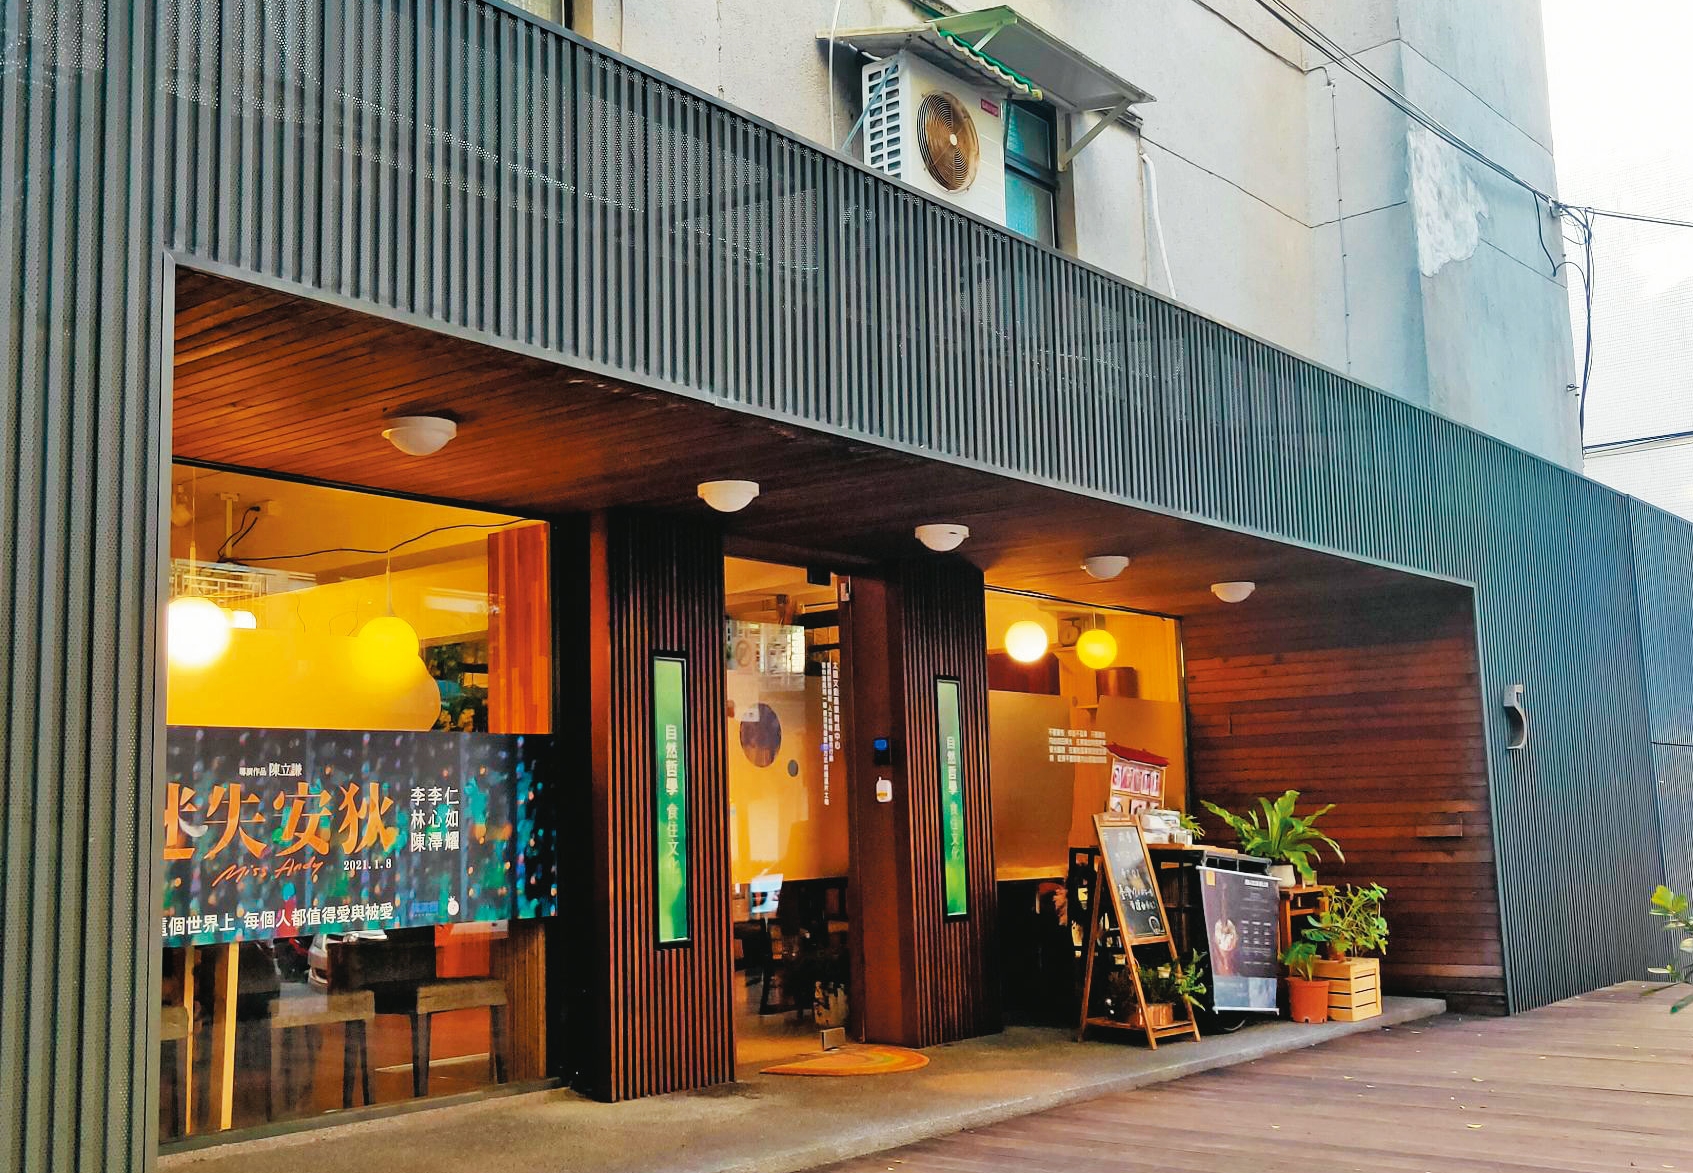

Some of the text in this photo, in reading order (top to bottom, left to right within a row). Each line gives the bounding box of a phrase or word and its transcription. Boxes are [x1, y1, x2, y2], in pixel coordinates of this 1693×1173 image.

[410, 786, 460, 806] 李李仁
[410, 808, 460, 829] 林心如
[410, 831, 460, 852] 陳澤耀
[211, 856, 324, 887] Miss Andy
[243, 902, 395, 931] 每個人都值得愛與被愛
